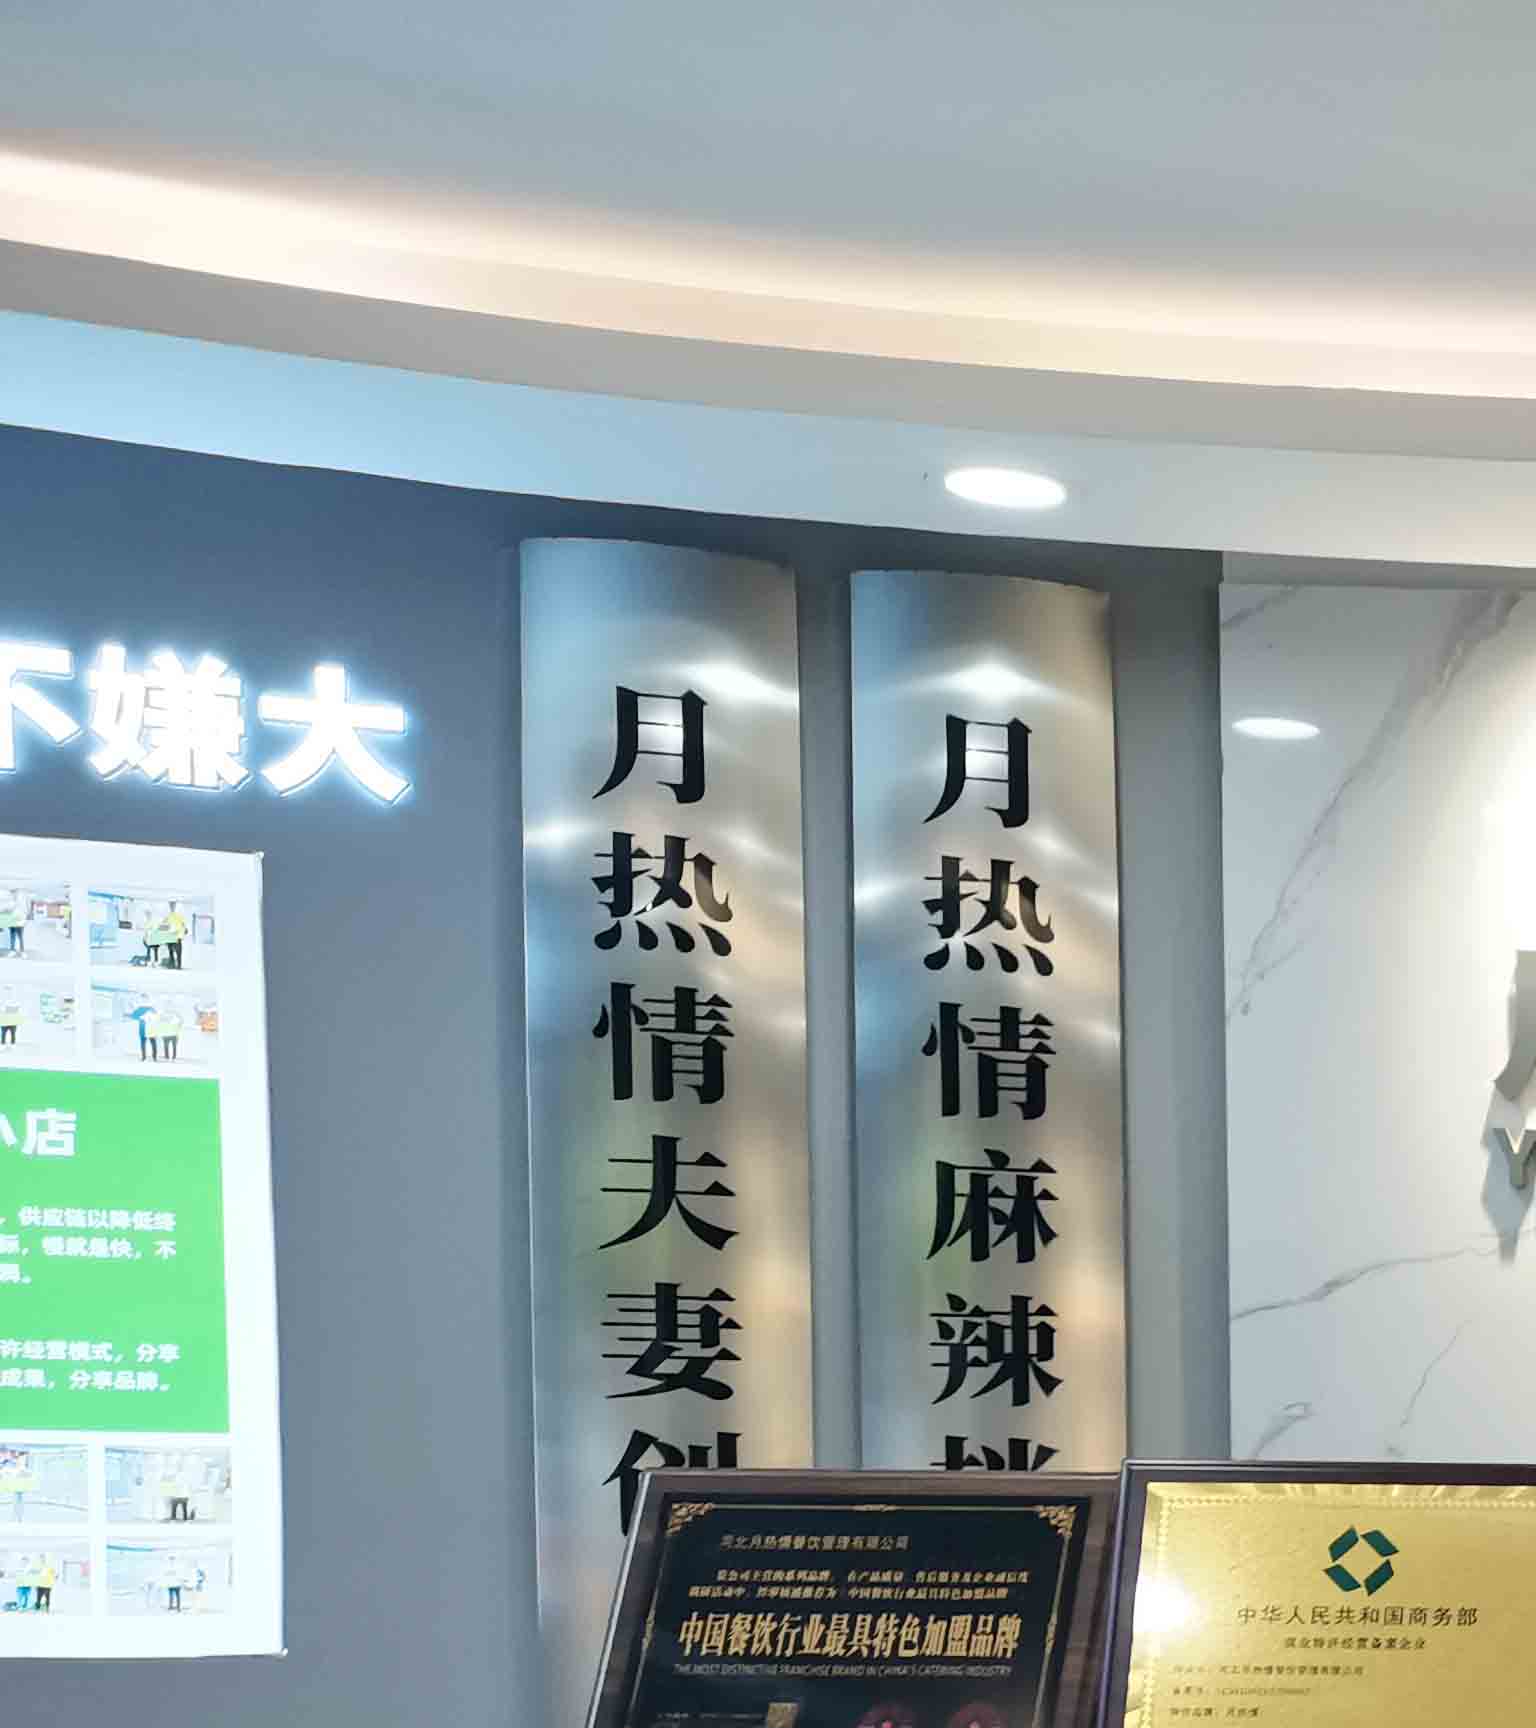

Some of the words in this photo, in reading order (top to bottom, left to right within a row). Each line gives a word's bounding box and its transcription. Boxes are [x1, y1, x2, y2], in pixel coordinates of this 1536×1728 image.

[1236, 1605, 1480, 1627] 中华人民共和国商务部
[678, 1611, 1023, 1660] 中国餐饮行业最具特色加盟品牌
